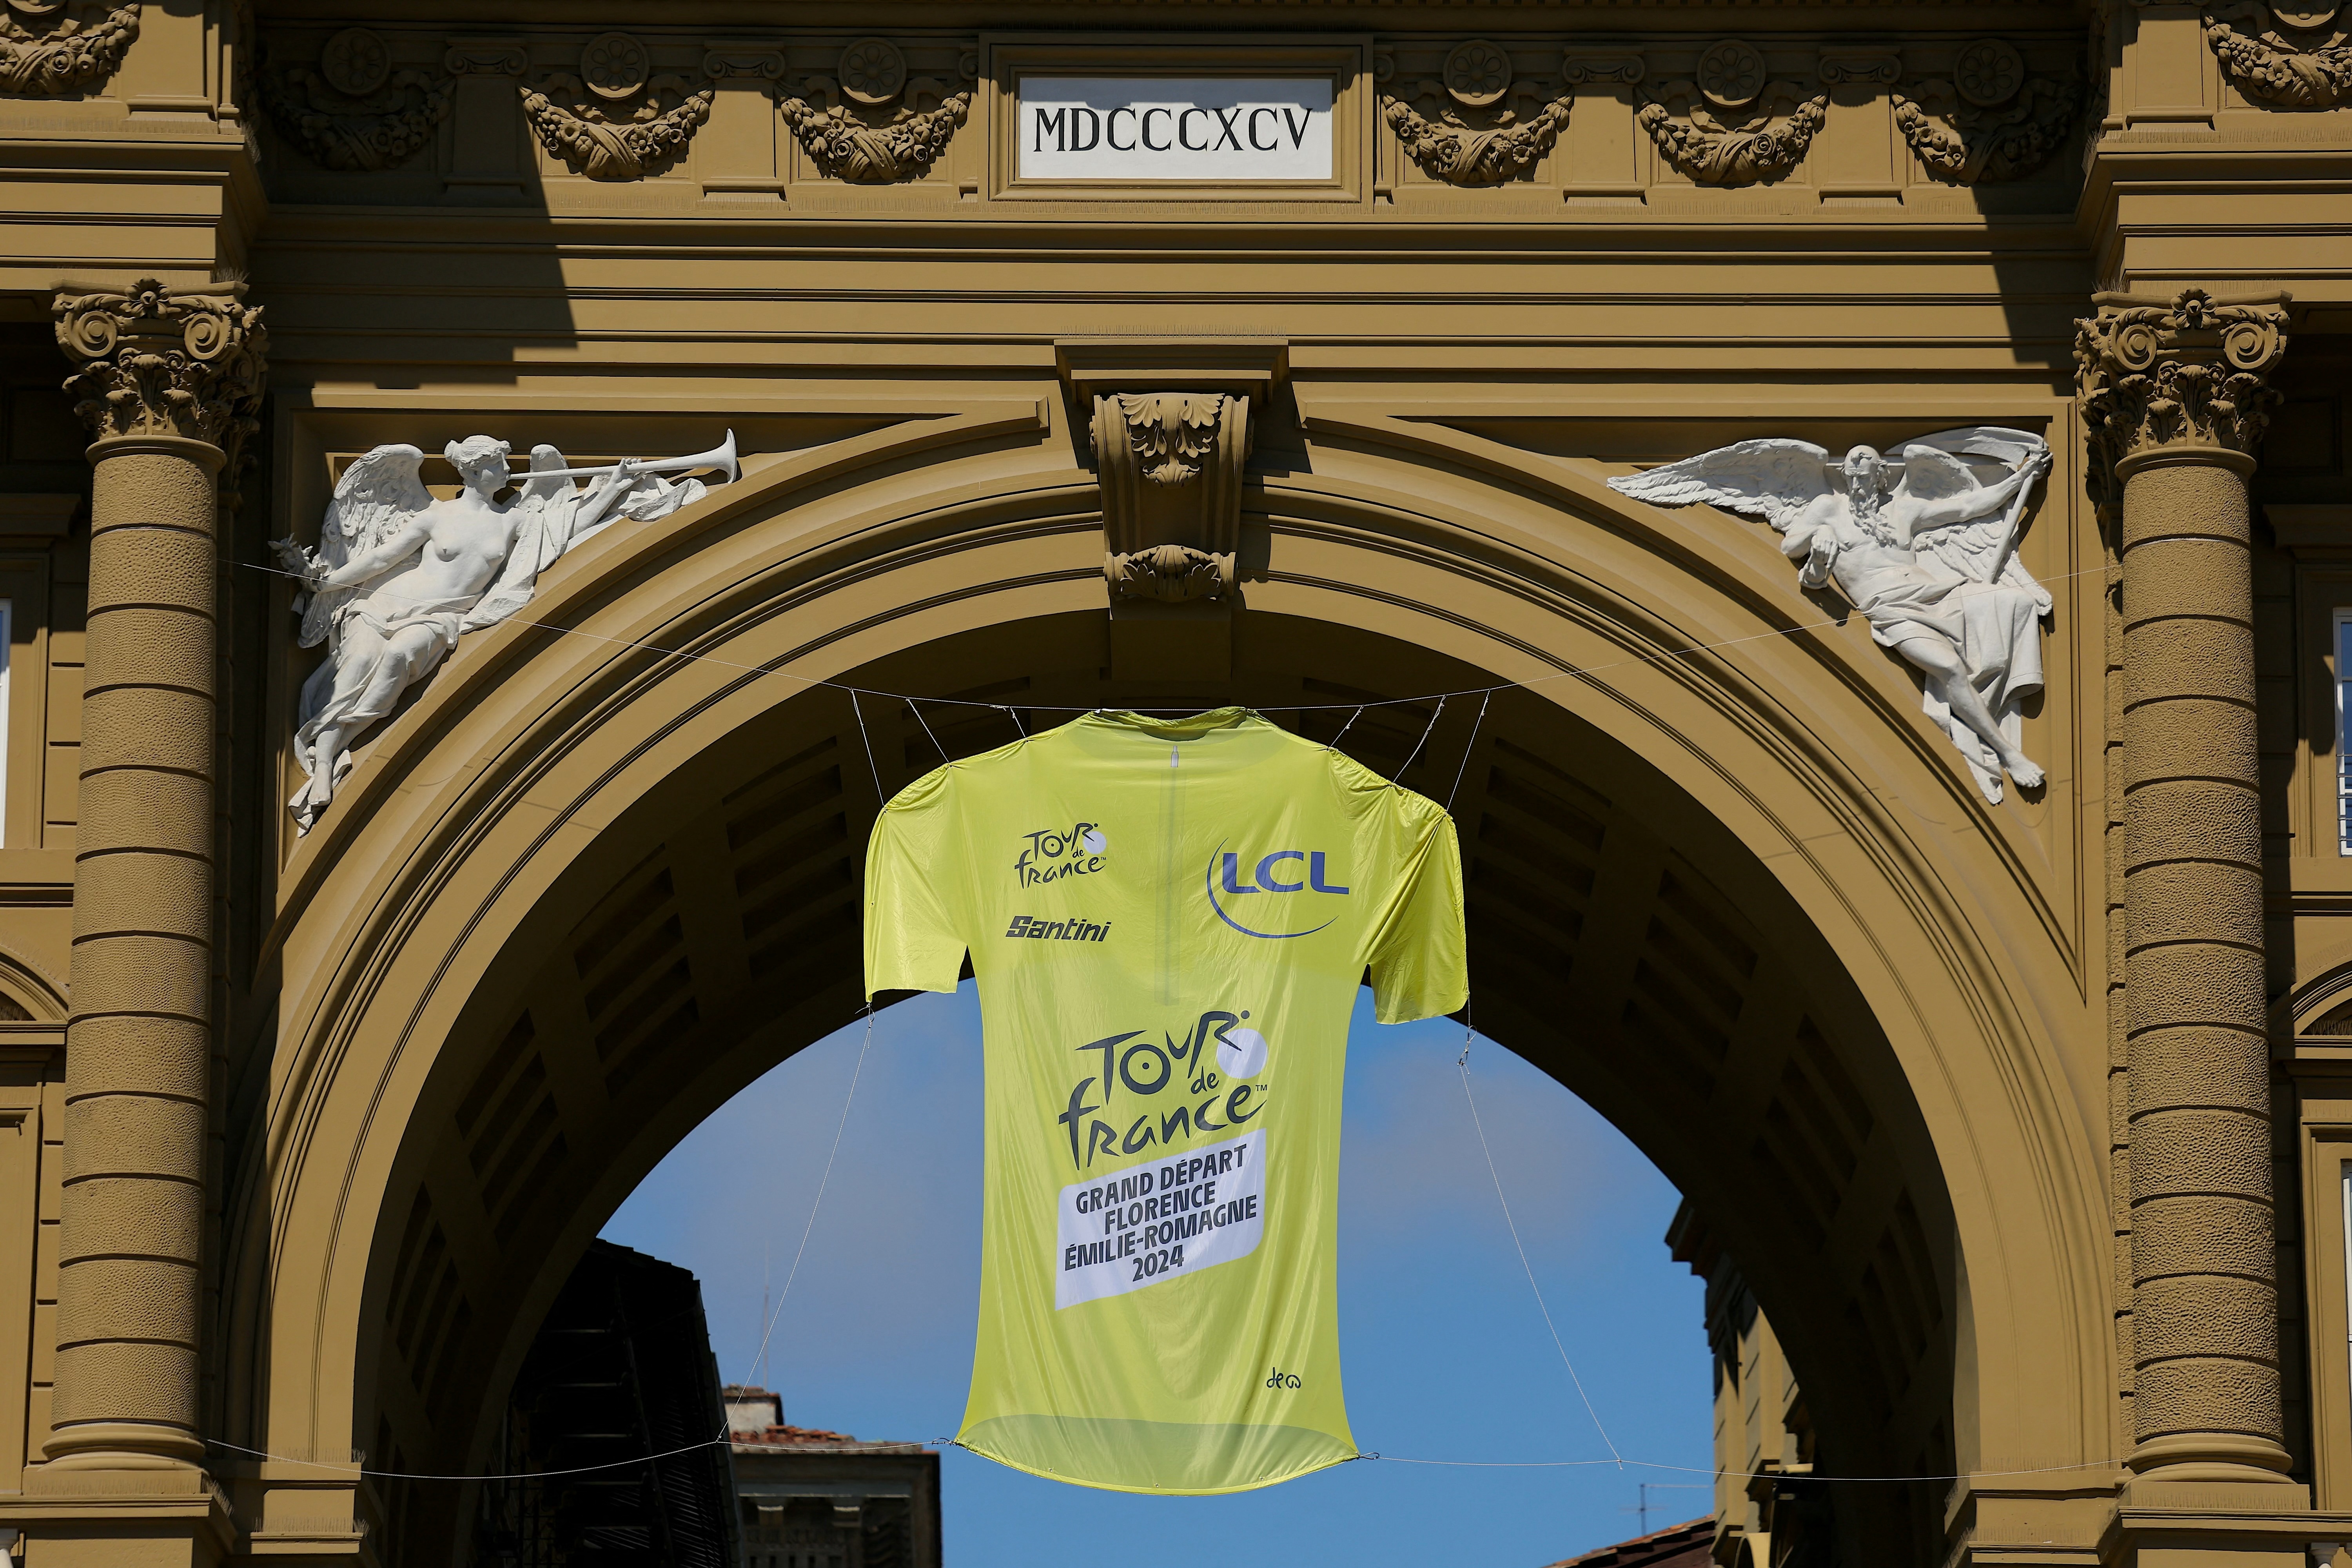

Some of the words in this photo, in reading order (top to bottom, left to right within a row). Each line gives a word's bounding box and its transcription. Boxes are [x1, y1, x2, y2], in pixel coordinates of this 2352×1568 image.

[1033, 107, 1313, 152] MDCCCXCV
[1222, 851, 1349, 895] LCL
[1005, 916, 1112, 942] Santini
[1191, 1066, 1219, 1094] de
[1076, 1172, 1153, 1214] GRAND
[1160, 1143, 1247, 1191] DÉPART
[1105, 1181, 1216, 1235] FLORENCE
[1065, 1194, 1257, 1271] ÉMILIE-ROMAGNE
[1132, 1245, 1184, 1282] 2024
